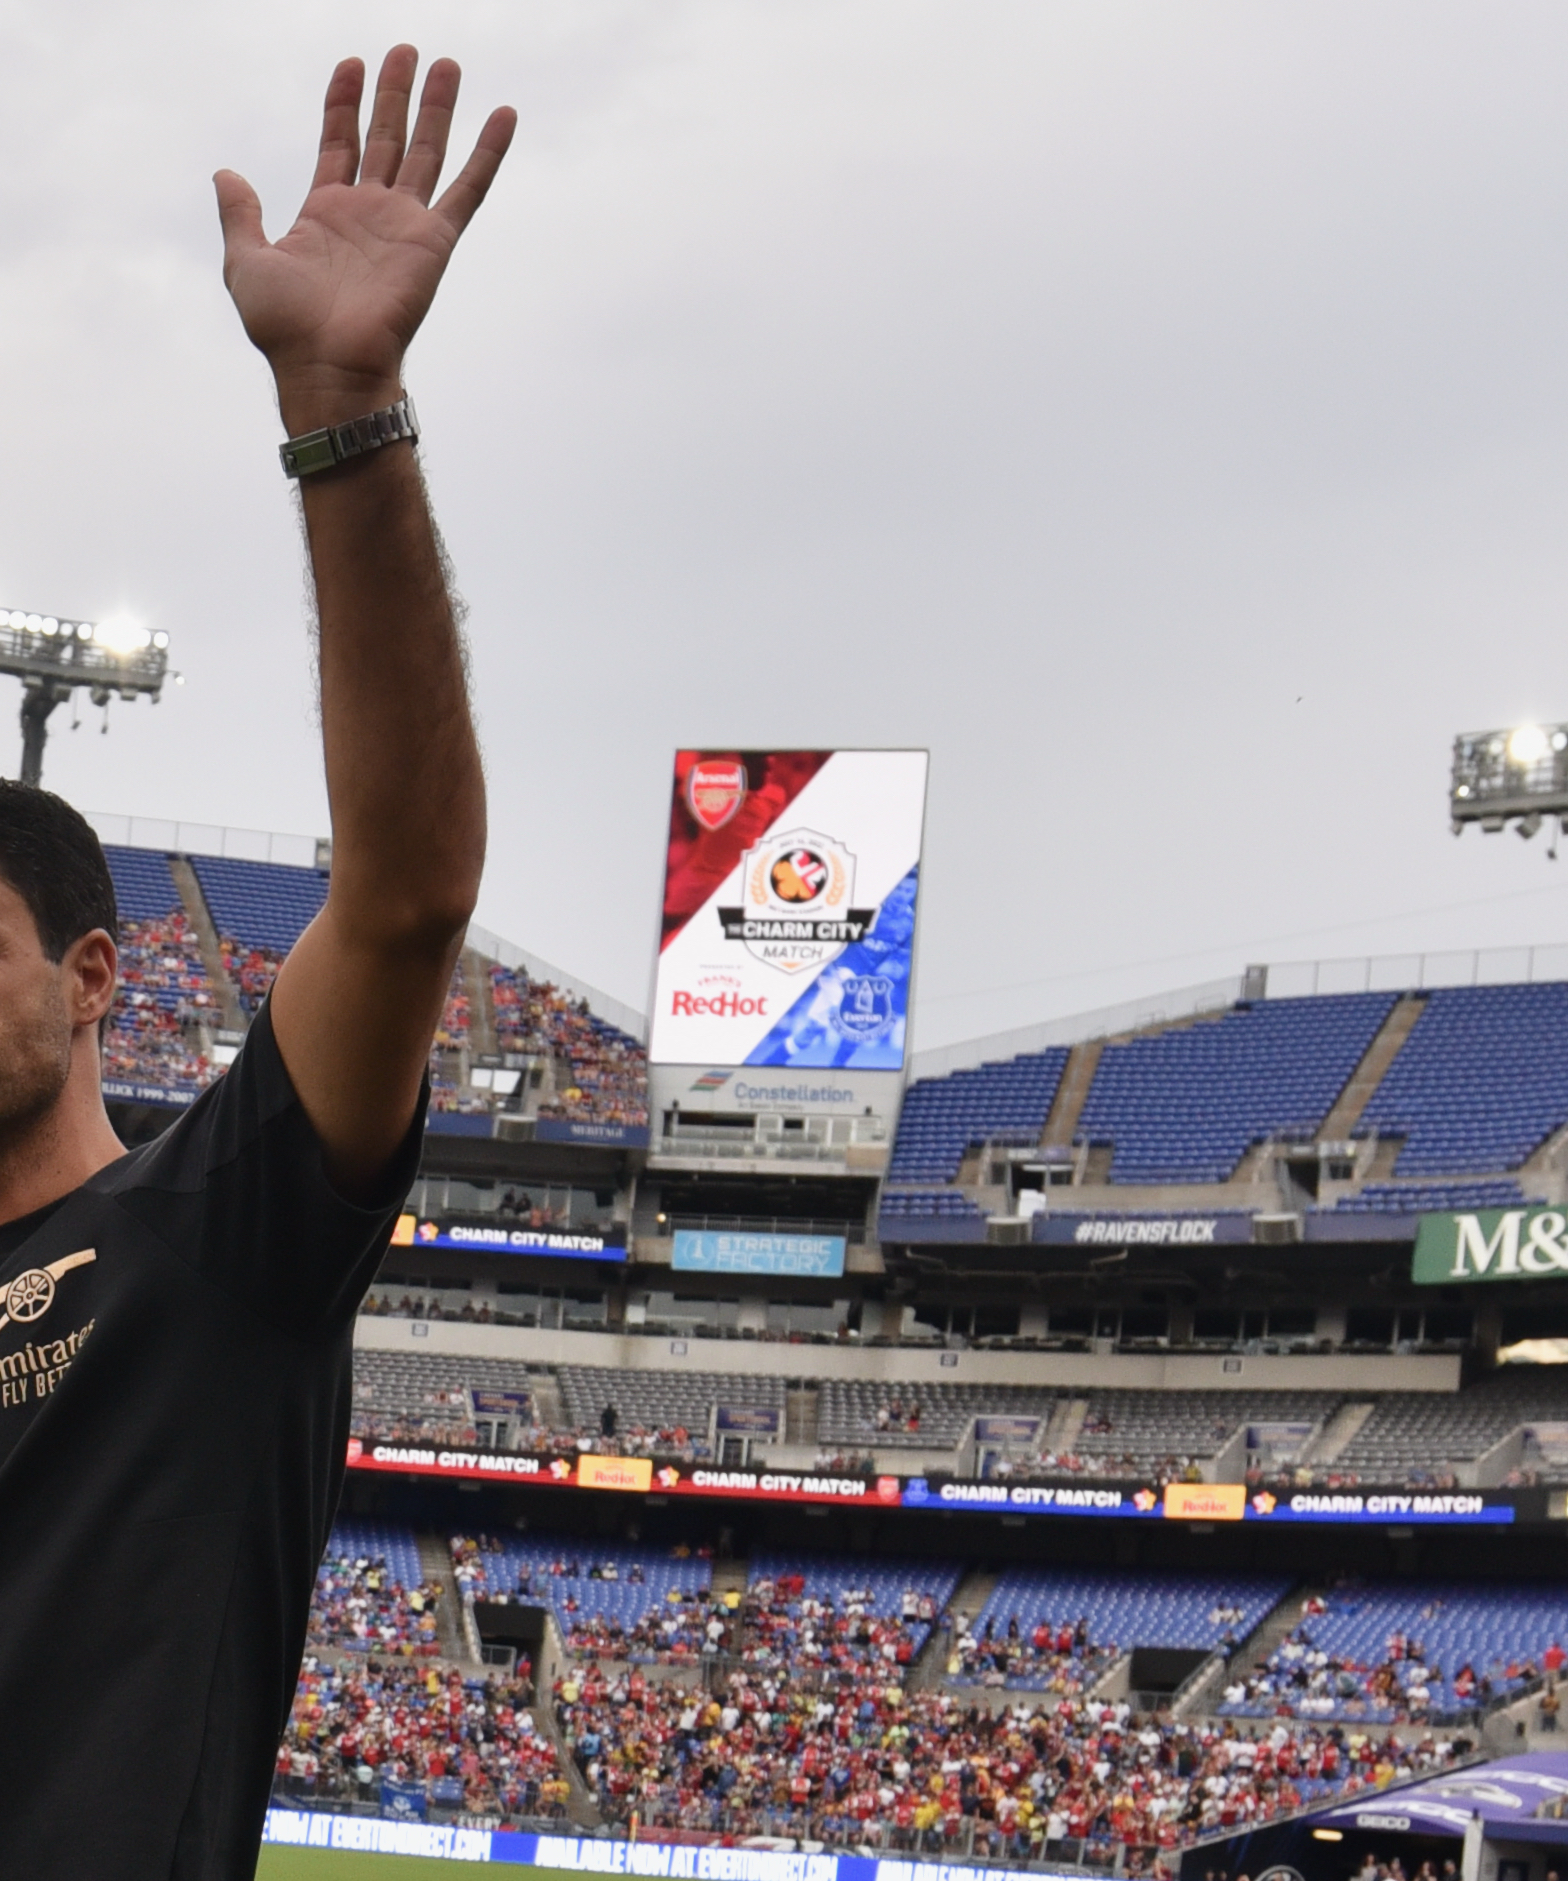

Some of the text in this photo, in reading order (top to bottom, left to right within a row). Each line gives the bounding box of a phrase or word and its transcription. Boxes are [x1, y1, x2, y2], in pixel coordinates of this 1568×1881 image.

[742, 921, 815, 940] CHARM
[816, 922, 864, 942] CITY
[763, 944, 824, 961] MATCH
[734, 1081, 855, 1103] Constellation
[449, 1226, 604, 1252] CHARM CITY MATCH
[1074, 1221, 1218, 1244] #RAVENSFLOCK
[1449, 1210, 1568, 1278] M&
[717, 1235, 832, 1257] STRATEGIC
[716, 1251, 830, 1274] FACTORY
[2, 1361, 72, 1408] FLY BET
[372, 1445, 540, 1474] CHARM CITY MATCH
[691, 1469, 866, 1497] CHARM CITY MATCH
[939, 1483, 1122, 1508] CHARM CITY MATCH
[1289, 1494, 1484, 1515] CHARM CITY MATCH
[268, 1808, 310, 1844] NOW
[308, 1812, 333, 1847] AT
[534, 1835, 628, 1875] AVAILABLE
[625, 1841, 672, 1878] NOW
[668, 1844, 699, 1880] AT
